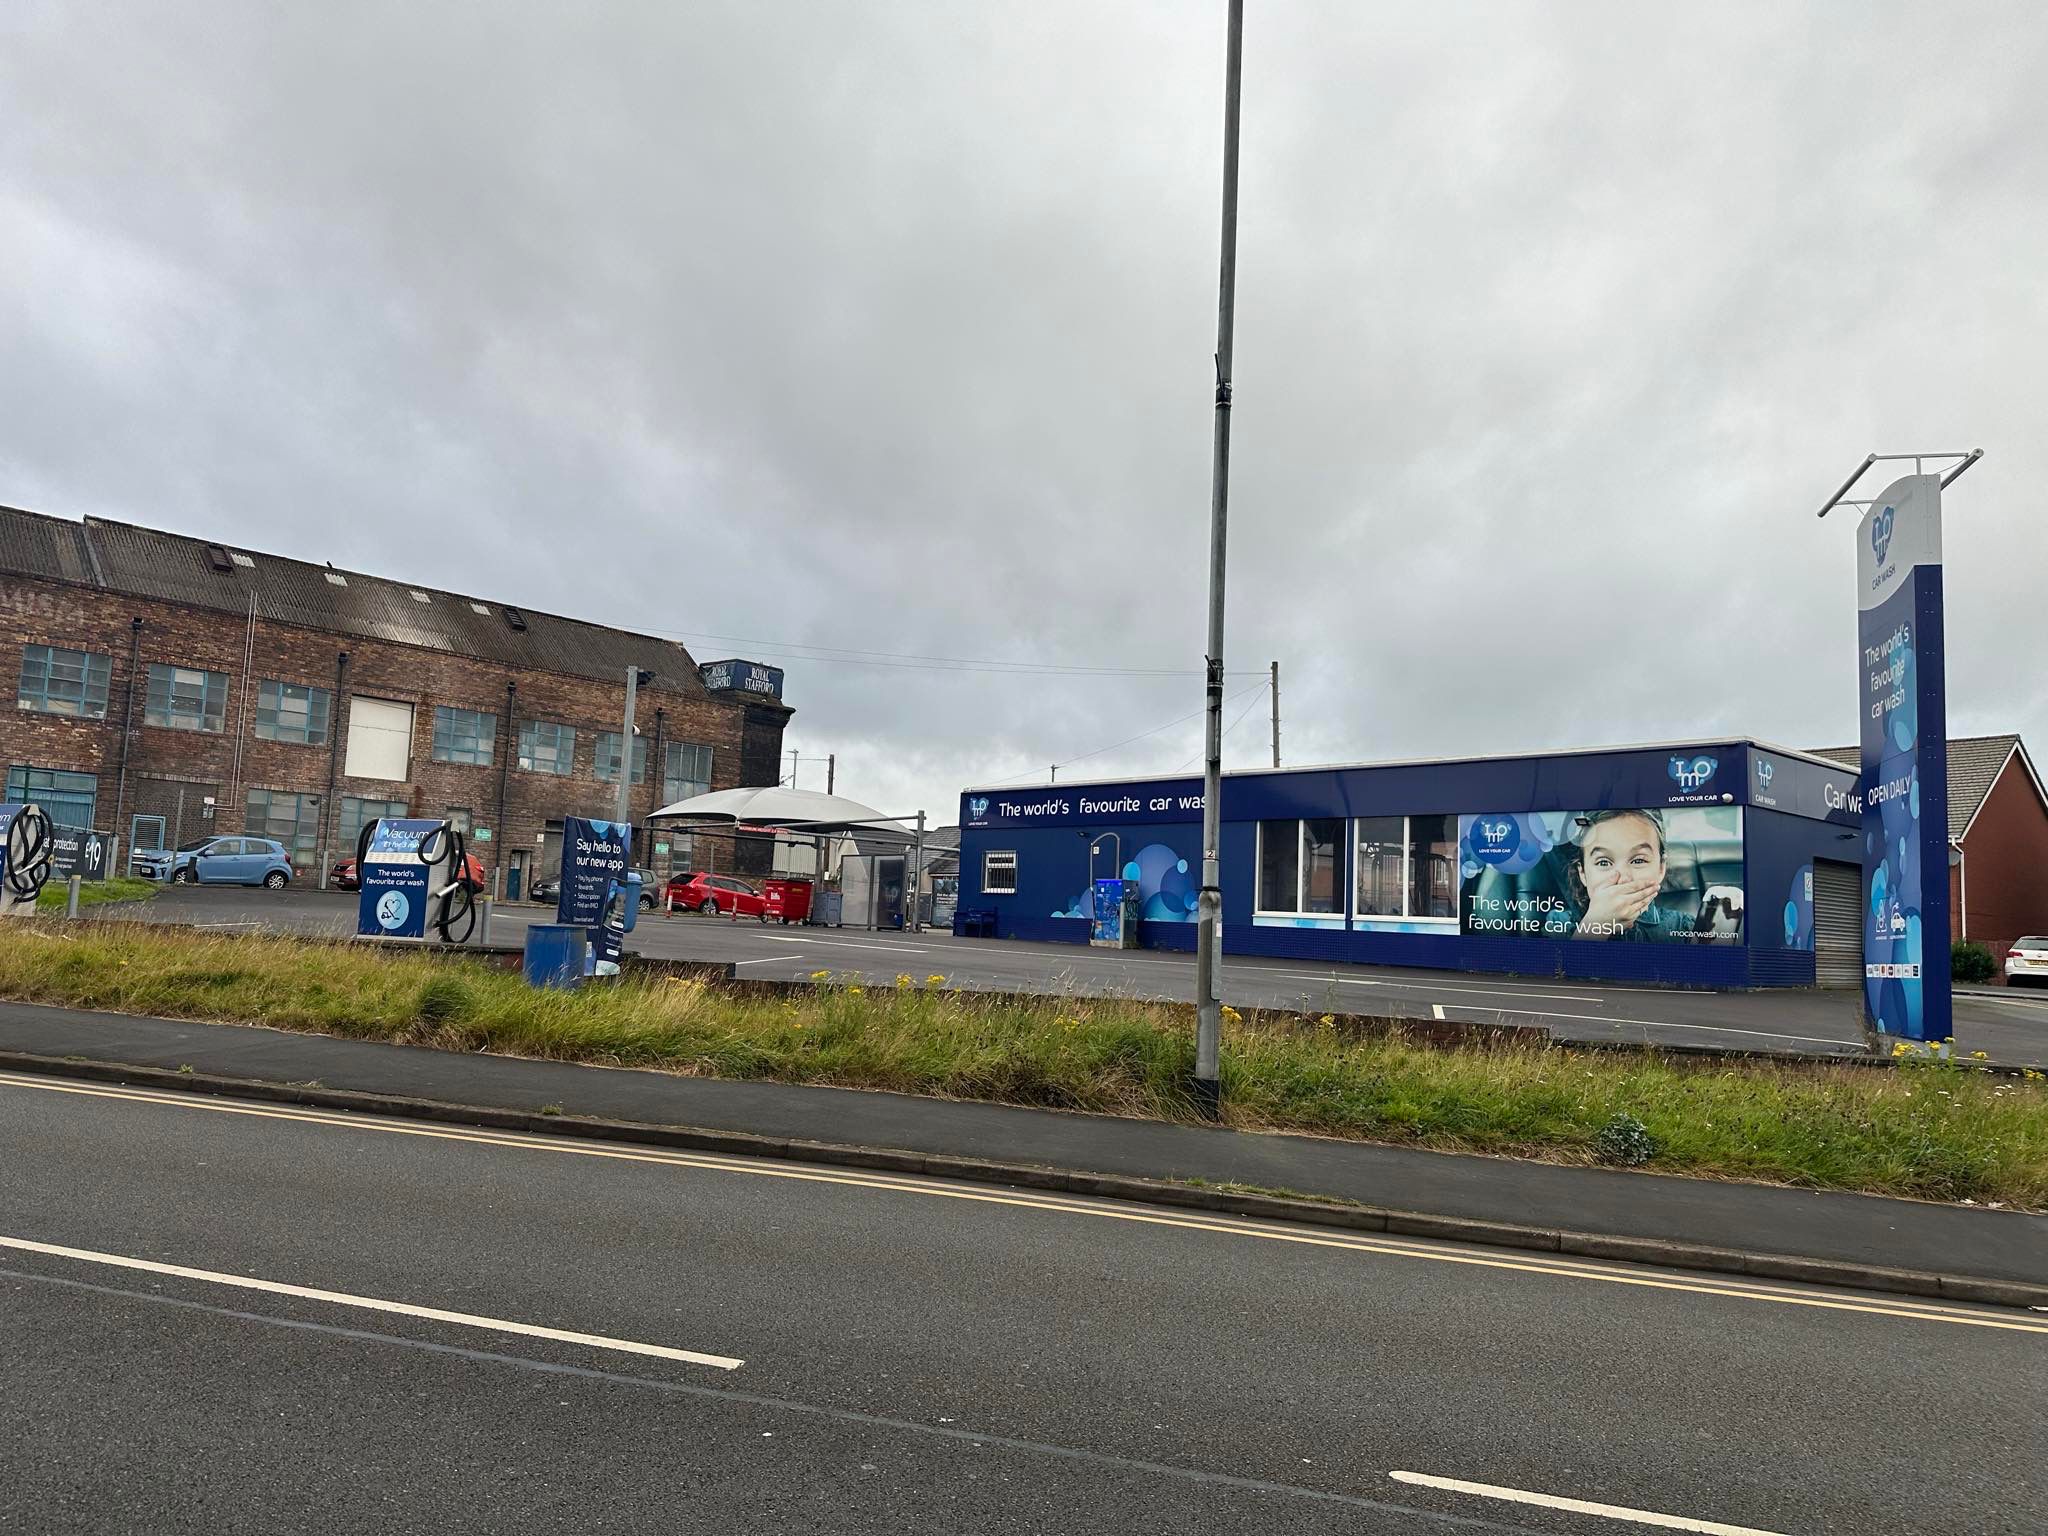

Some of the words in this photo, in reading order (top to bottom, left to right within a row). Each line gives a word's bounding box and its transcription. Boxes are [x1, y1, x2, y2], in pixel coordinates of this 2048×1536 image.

[1872, 575, 1881, 591] CAR
[1881, 563, 1896, 583] WASH
[1865, 646, 1879, 667] The
[1880, 624, 1909, 658] world's
[752, 667, 769, 682] ROYAL
[1871, 658, 1904, 692] favourite
[745, 678, 774, 694] STAFFORD
[1871, 700, 1884, 719] car
[1885, 684, 1905, 712] wash
[1824, 782, 1845, 810] Car
[1868, 785, 1889, 806] OPEN
[1890, 775, 1911, 800] DAILY
[999, 803, 1021, 817] The
[1024, 799, 1070, 816] world's
[1079, 796, 1140, 814] favourite
[1150, 797, 1172, 811] car
[1178, 796, 1206, 809] was
[385, 829, 429, 839] Vacuum
[53, 838, 78, 851] protection
[577, 839, 591, 854] Say
[593, 841, 611, 852] hello
[612, 843, 621, 854] to
[85, 841, 101, 870] £19
[576, 857, 589, 866] our
[590, 858, 606, 867] new
[607, 860, 624, 871] app
[378, 869, 390, 877] The
[1468, 895, 1500, 911] The
[1504, 896, 1564, 912] world's
[1468, 914, 1540, 932] favourite
[1544, 919, 1572, 933] car
[1576, 919, 1624, 936] wash
[1669, 929, 1739, 940] imocarwash.com
